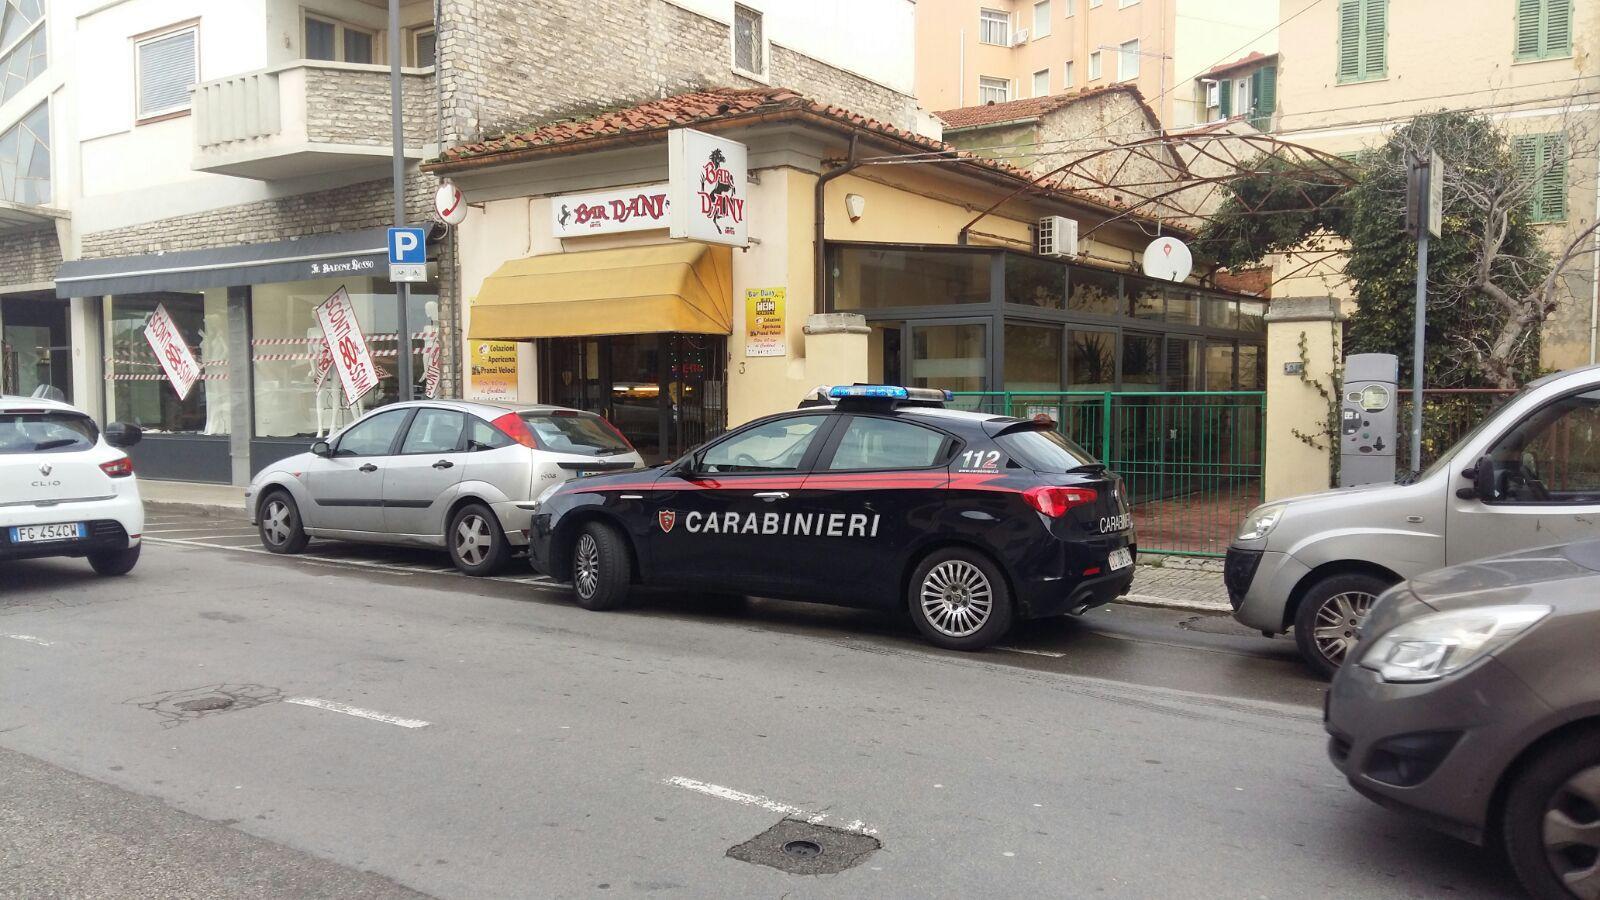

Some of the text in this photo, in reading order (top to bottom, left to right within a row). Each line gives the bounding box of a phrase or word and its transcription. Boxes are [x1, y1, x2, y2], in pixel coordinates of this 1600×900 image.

[609, 194, 667, 223] DANY
[698, 191, 744, 223] DANY
[394, 231, 418, 261] P
[490, 344, 515, 352] Colazioni
[488, 356, 515, 364] Apericena
[738, 361, 746, 375] 3
[962, 450, 1001, 469] 112
[19, 523, 77, 540] FG 454CW
[685, 511, 881, 538] CARABINIERI
